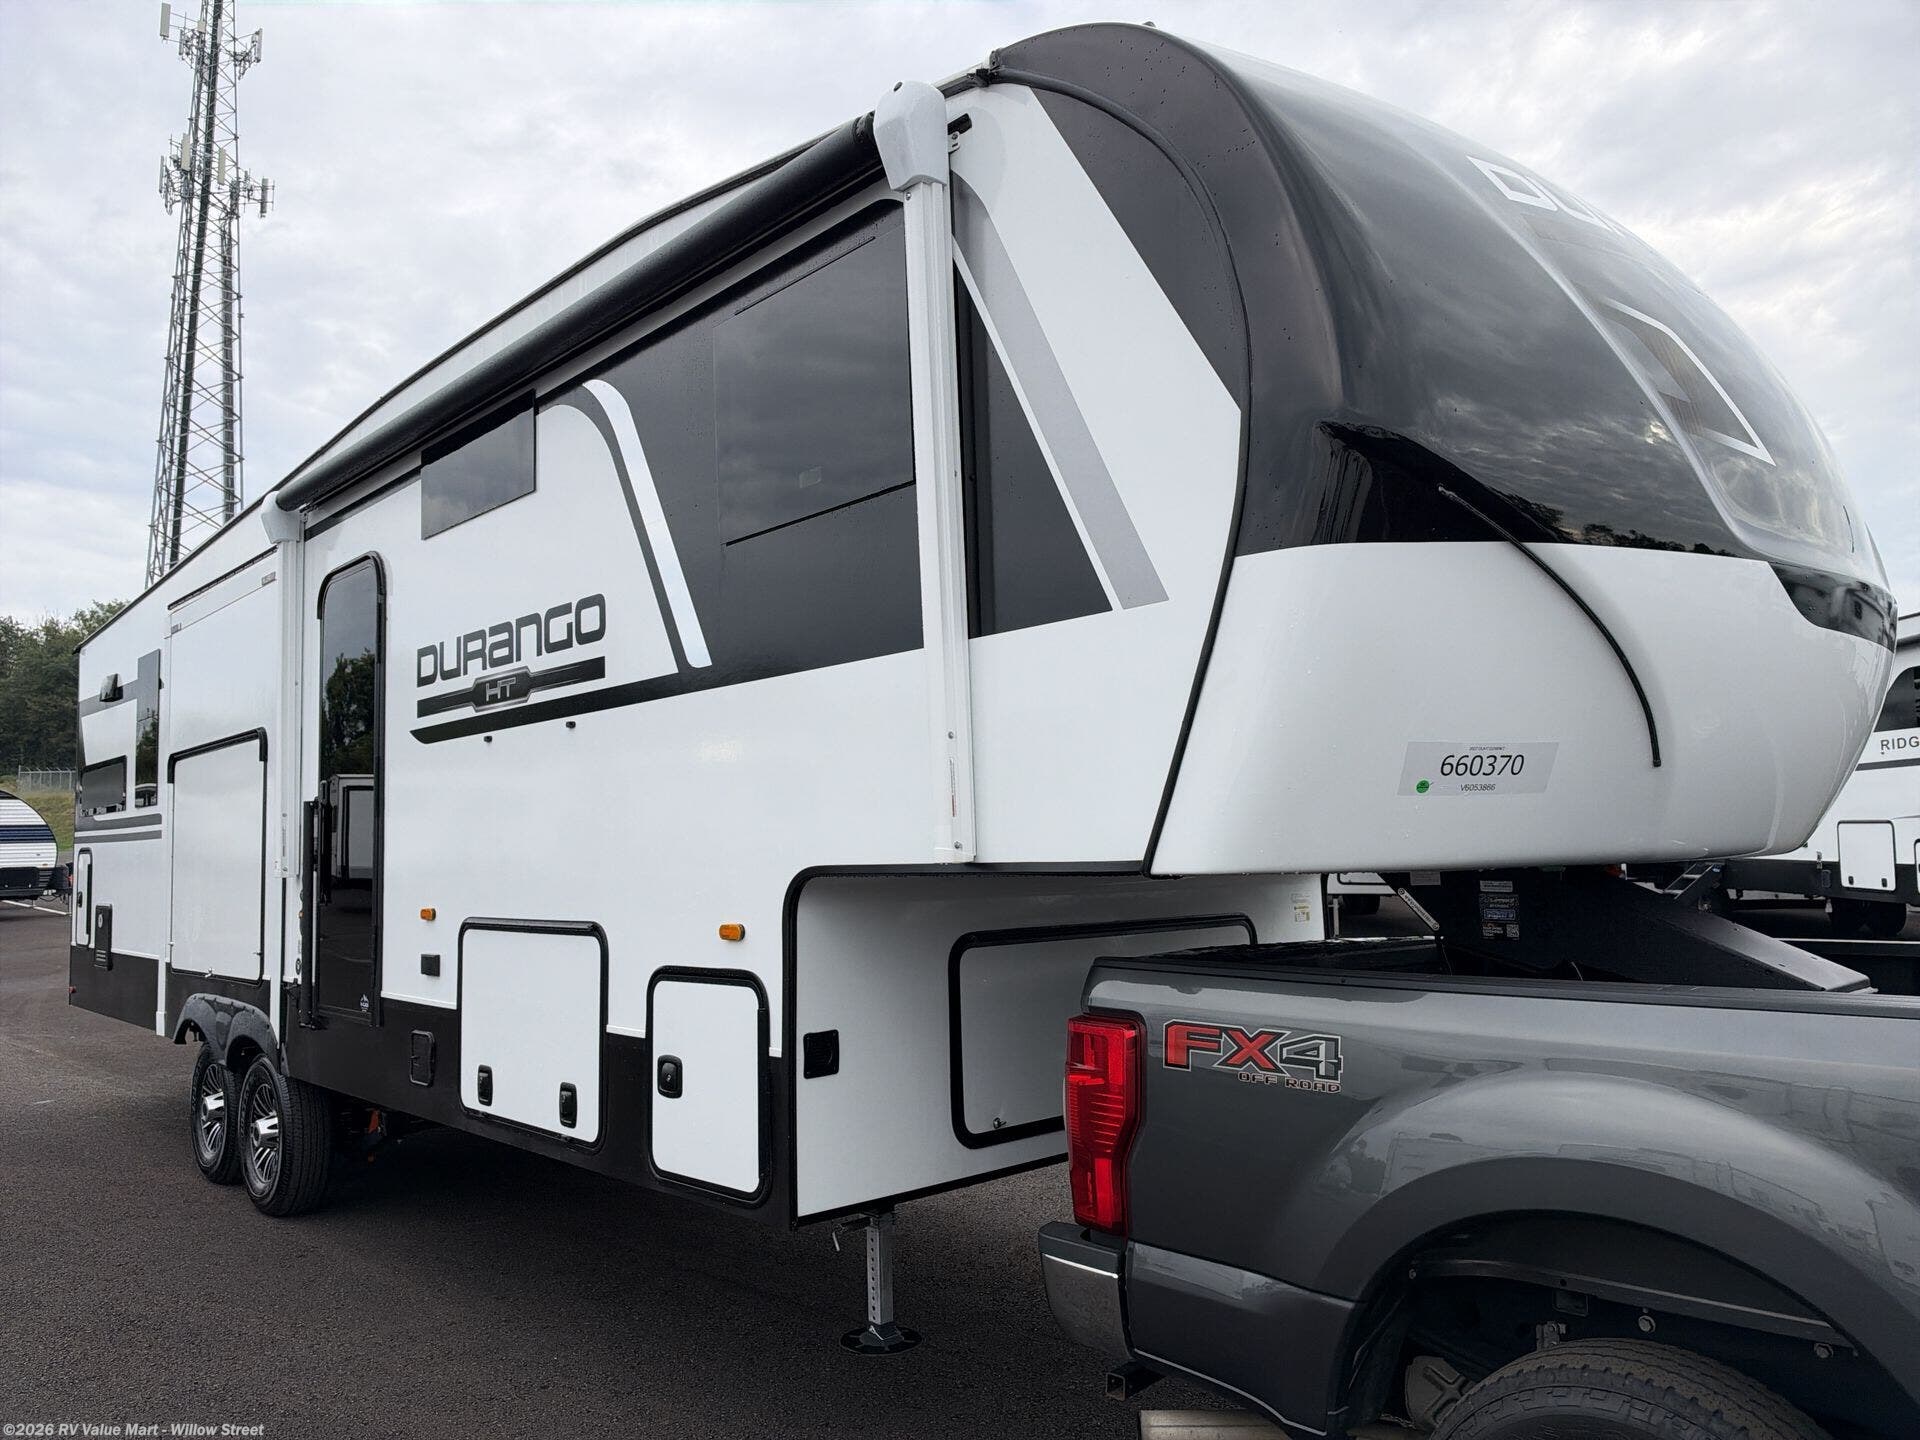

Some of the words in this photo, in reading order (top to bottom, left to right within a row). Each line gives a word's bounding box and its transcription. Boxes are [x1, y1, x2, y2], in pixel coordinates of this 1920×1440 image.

[417, 594, 606, 687] DURANGO
[485, 677, 516, 701] HT
[1440, 754, 1525, 776] 660370
[1163, 1019, 1343, 1082] FX4
[1238, 1071, 1278, 1085] OFF
[1285, 1077, 1342, 1094] ROAD
